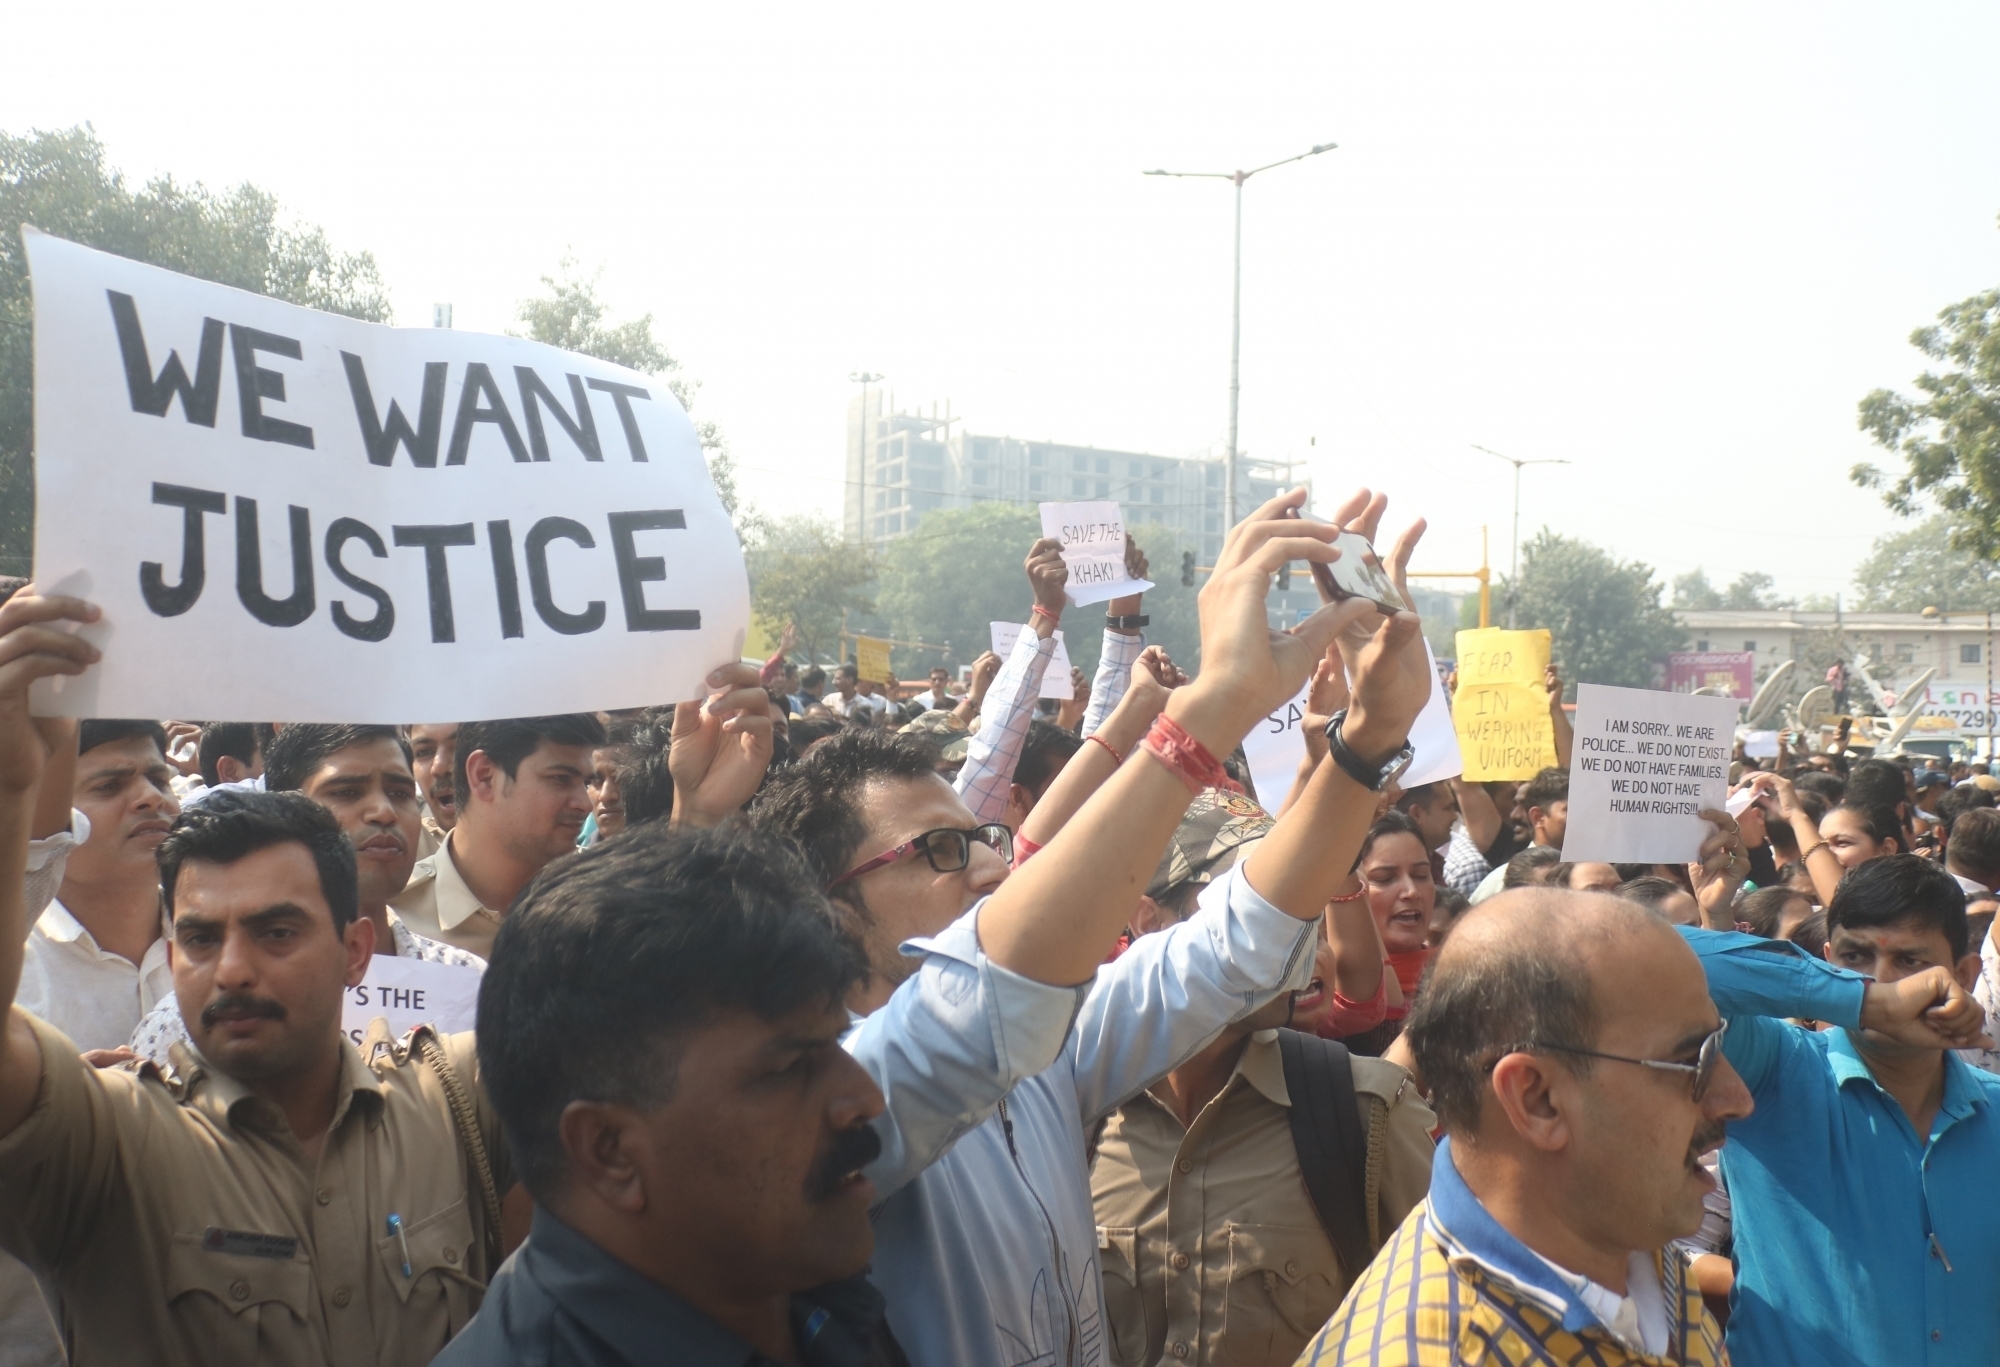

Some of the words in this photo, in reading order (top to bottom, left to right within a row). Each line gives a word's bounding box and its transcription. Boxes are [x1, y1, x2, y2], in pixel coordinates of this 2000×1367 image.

[106, 289, 314, 449] WE
[339, 350, 651, 468] WANT
[1063, 524, 1096, 545] SAVE
[1099, 522, 1121, 541] THE
[139, 481, 700, 644] JUSTICE
[1073, 561, 1114, 585] KHAKI
[1461, 651, 1513, 677] FEAR
[1476, 690, 1509, 715] IN
[1267, 699, 1307, 734] SA
[1467, 720, 1542, 745] WEARING
[1606, 719, 1609, 732] I
[1612, 720, 1629, 733] AM
[1632, 721, 1673, 737] SORRY..
[1676, 725, 1692, 739] WE
[1694, 727, 1714, 740] ARE
[1480, 746, 1542, 770] UNIFORM
[1582, 737, 1634, 754] POLICE...
[1638, 742, 1654, 755] WE
[1656, 743, 1672, 756] DO
[1674, 744, 1696, 758] NOT
[1699, 746, 1728, 760] EXIST..
[1581, 758, 1601, 771] WE
[1604, 759, 1621, 773] DO
[1624, 761, 1647, 774] NOT
[1649, 762, 1676, 776] HAVE
[1678, 764, 1726, 779] FAMILIES..
[1612, 780, 1629, 792] WE
[1632, 781, 1648, 793] DO
[1650, 782, 1673, 795] NOT
[1675, 783, 1701, 796] HAVE
[1610, 799, 1650, 812] HUMAN
[1652, 801, 1698, 815] RIGHTS!!!
[377, 987, 425, 1010] THE
